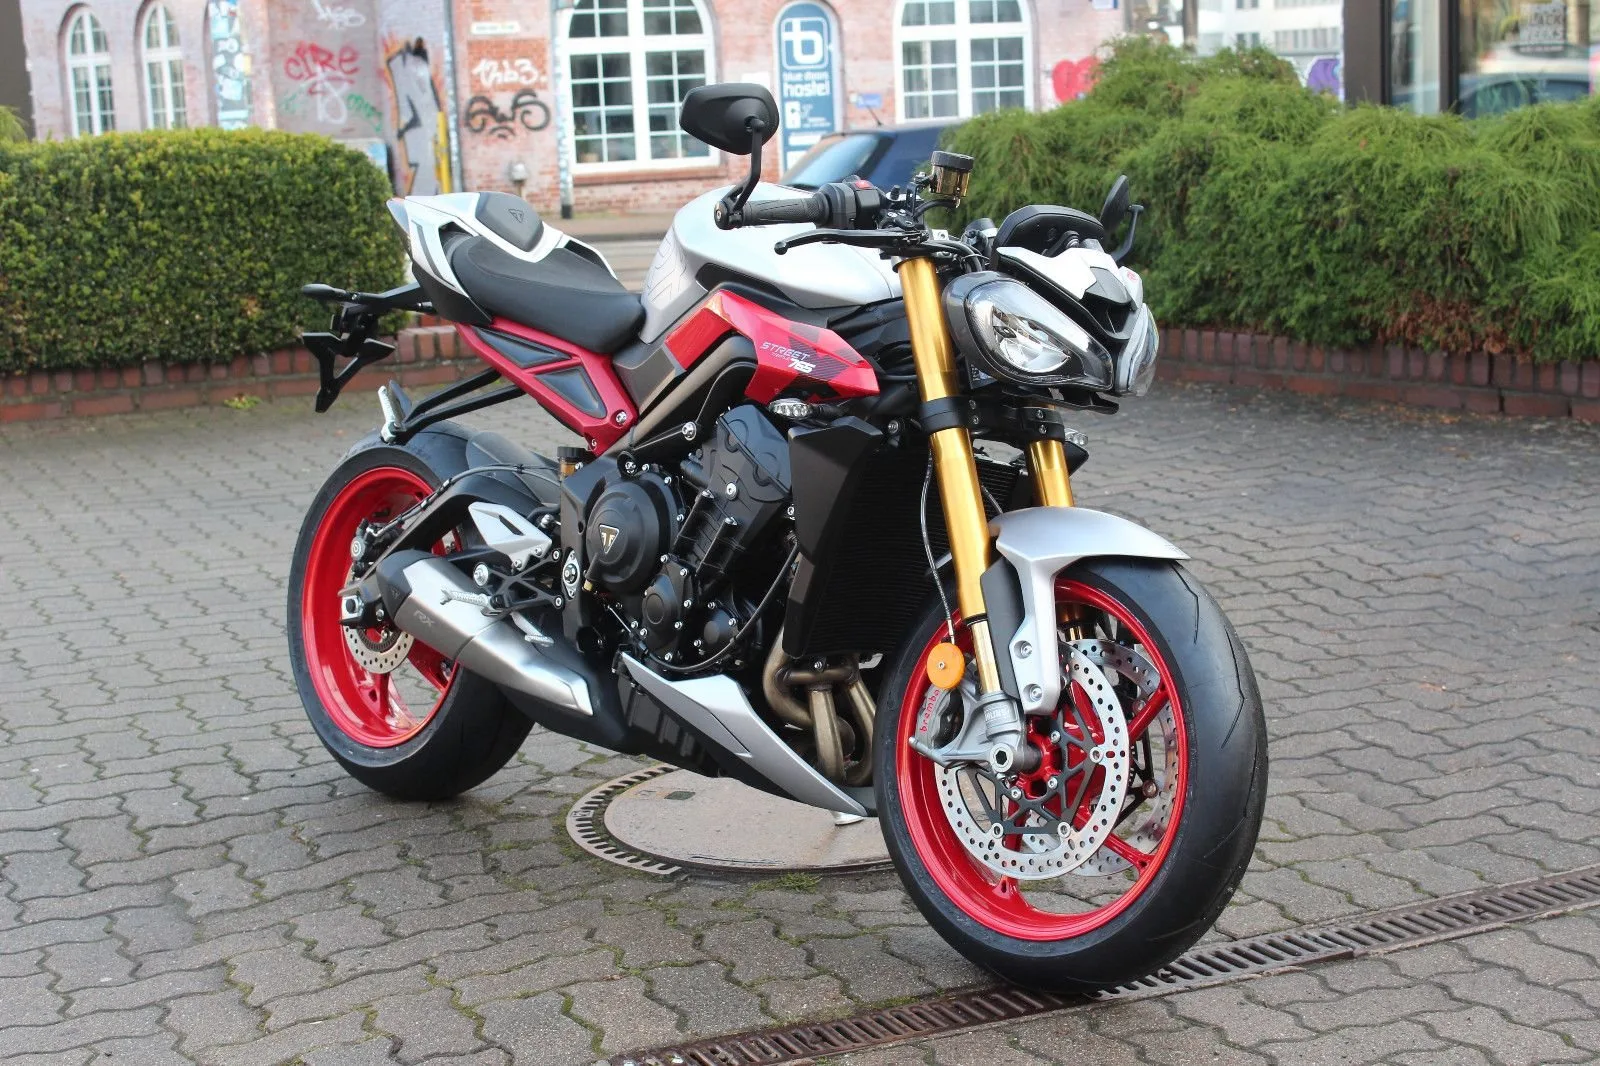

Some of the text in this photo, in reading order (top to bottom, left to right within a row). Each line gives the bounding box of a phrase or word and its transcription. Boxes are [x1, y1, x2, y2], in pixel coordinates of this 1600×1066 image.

[783, 80, 830, 97] hostel
[760, 341, 810, 361] STREET
[788, 358, 816, 374] 765
[920, 689, 940, 733] brembo
